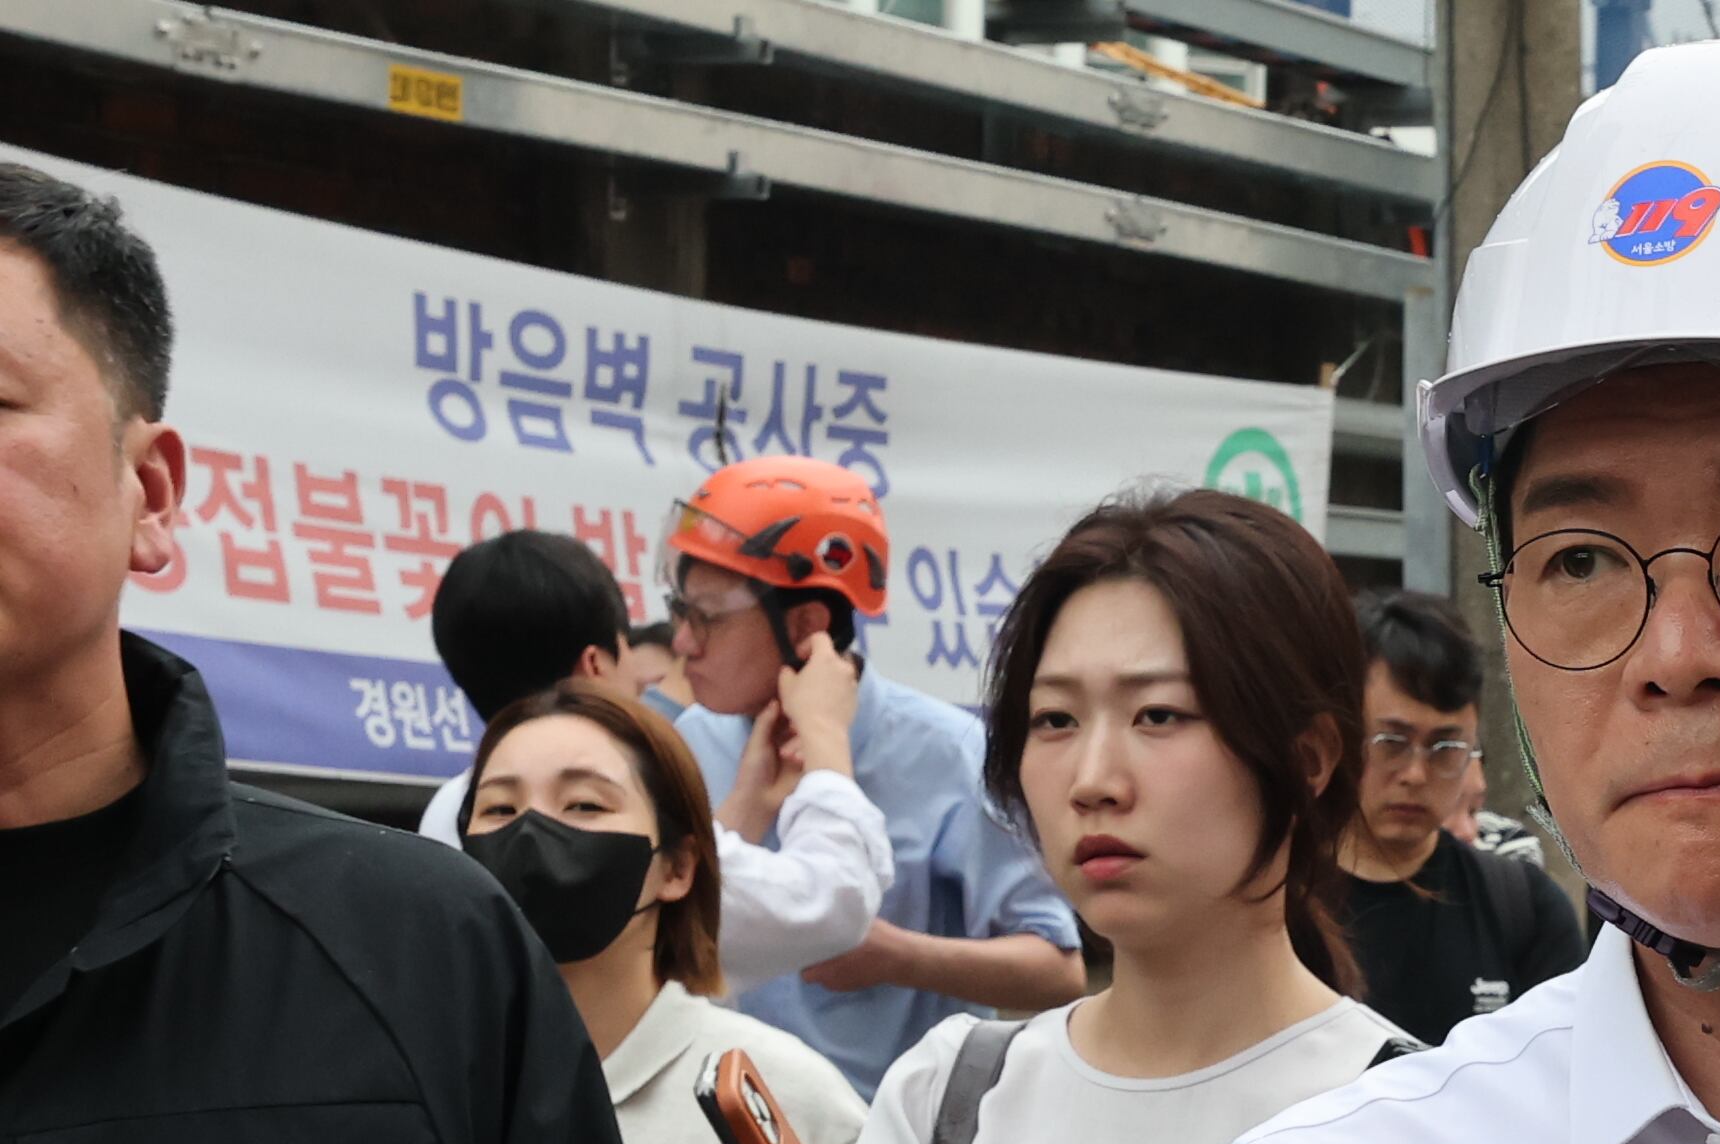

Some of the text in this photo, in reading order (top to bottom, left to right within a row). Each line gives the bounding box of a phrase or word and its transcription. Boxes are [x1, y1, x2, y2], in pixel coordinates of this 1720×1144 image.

[1631, 240, 1676, 256] 서울소방
[412, 291, 891, 500] 방음벽 공사중
[349, 678, 475, 753] 경원선
